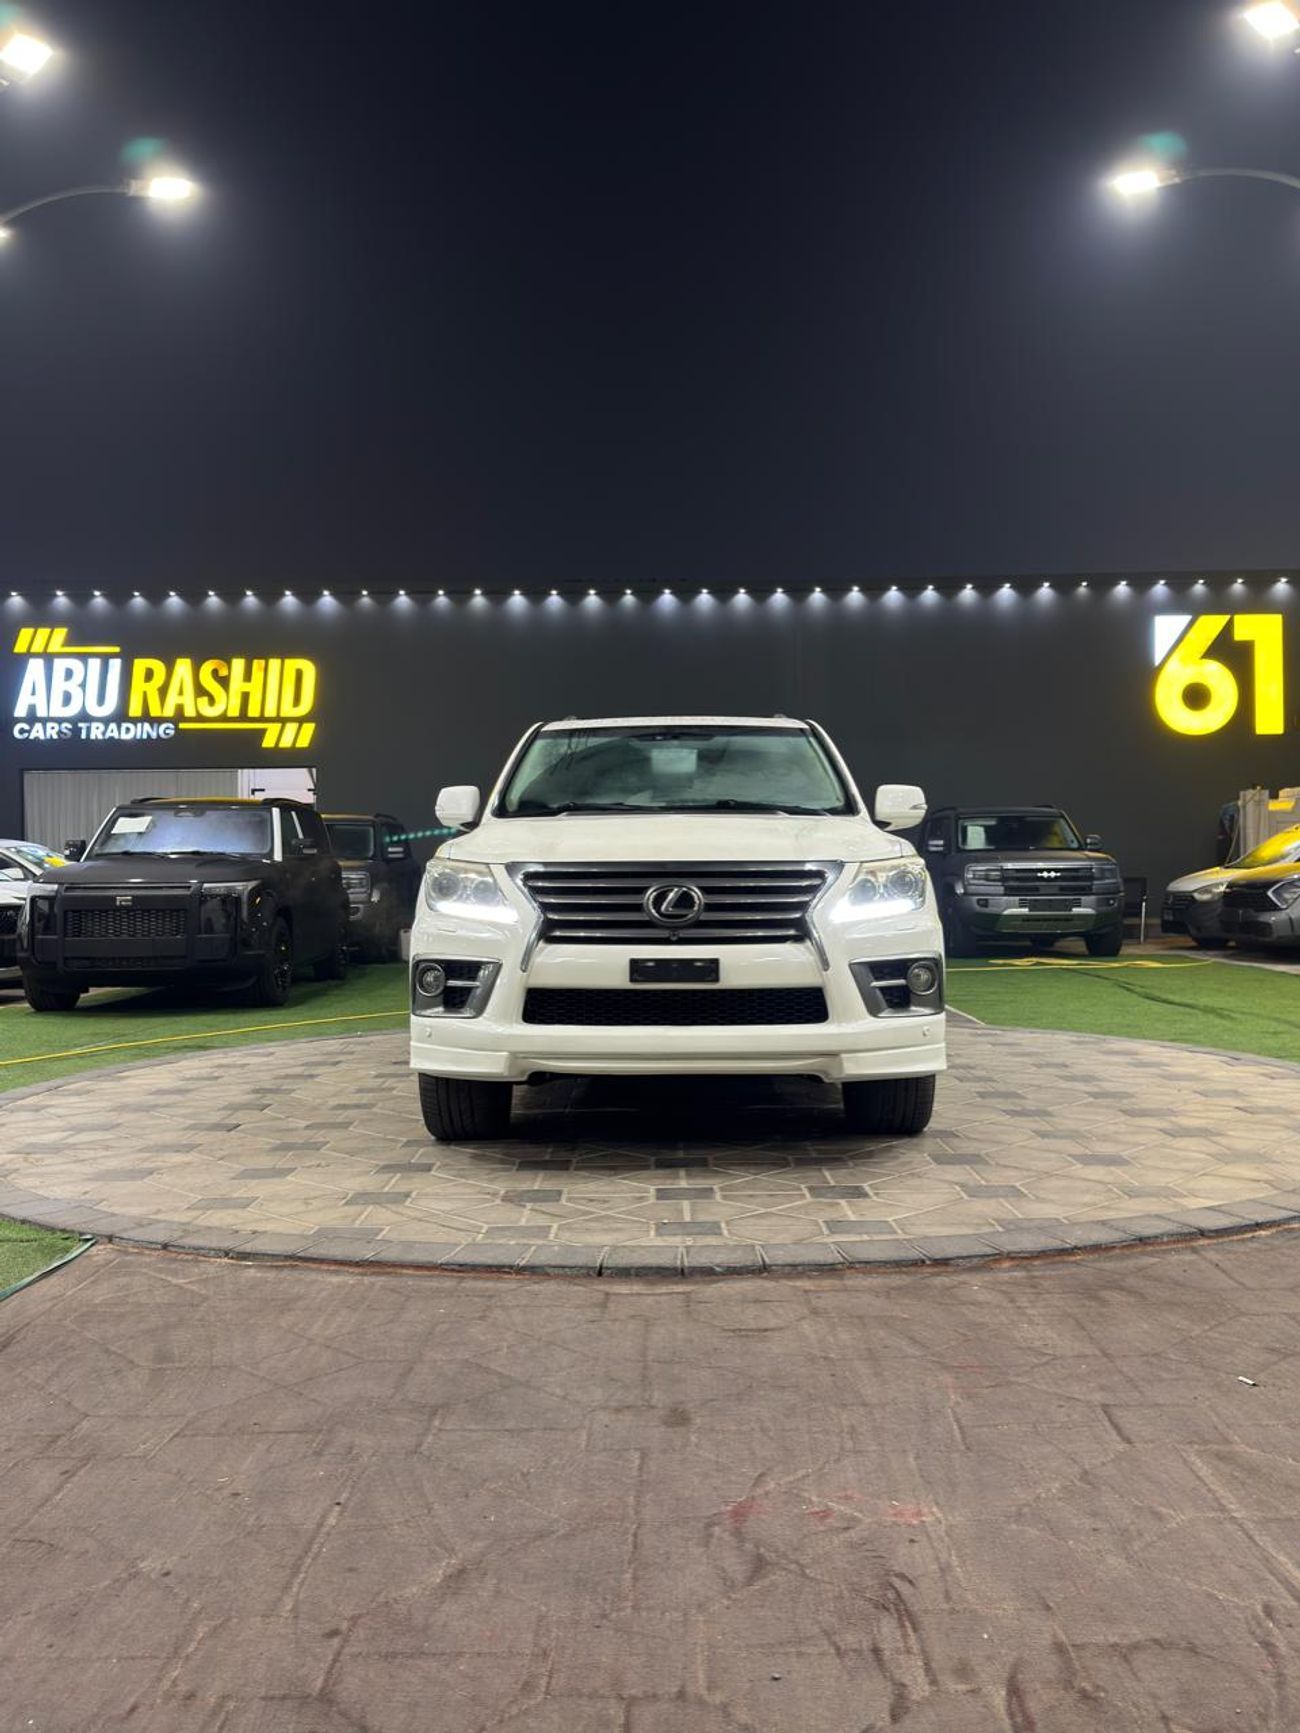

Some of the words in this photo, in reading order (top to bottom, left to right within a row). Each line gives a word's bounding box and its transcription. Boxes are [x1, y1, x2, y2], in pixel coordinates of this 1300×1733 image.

[13, 658, 121, 717] ABU
[128, 658, 316, 717] RASHID
[1155, 614, 1284, 735] 61
[13, 722, 72, 740] CARS
[78, 722, 175, 740] TRADING
